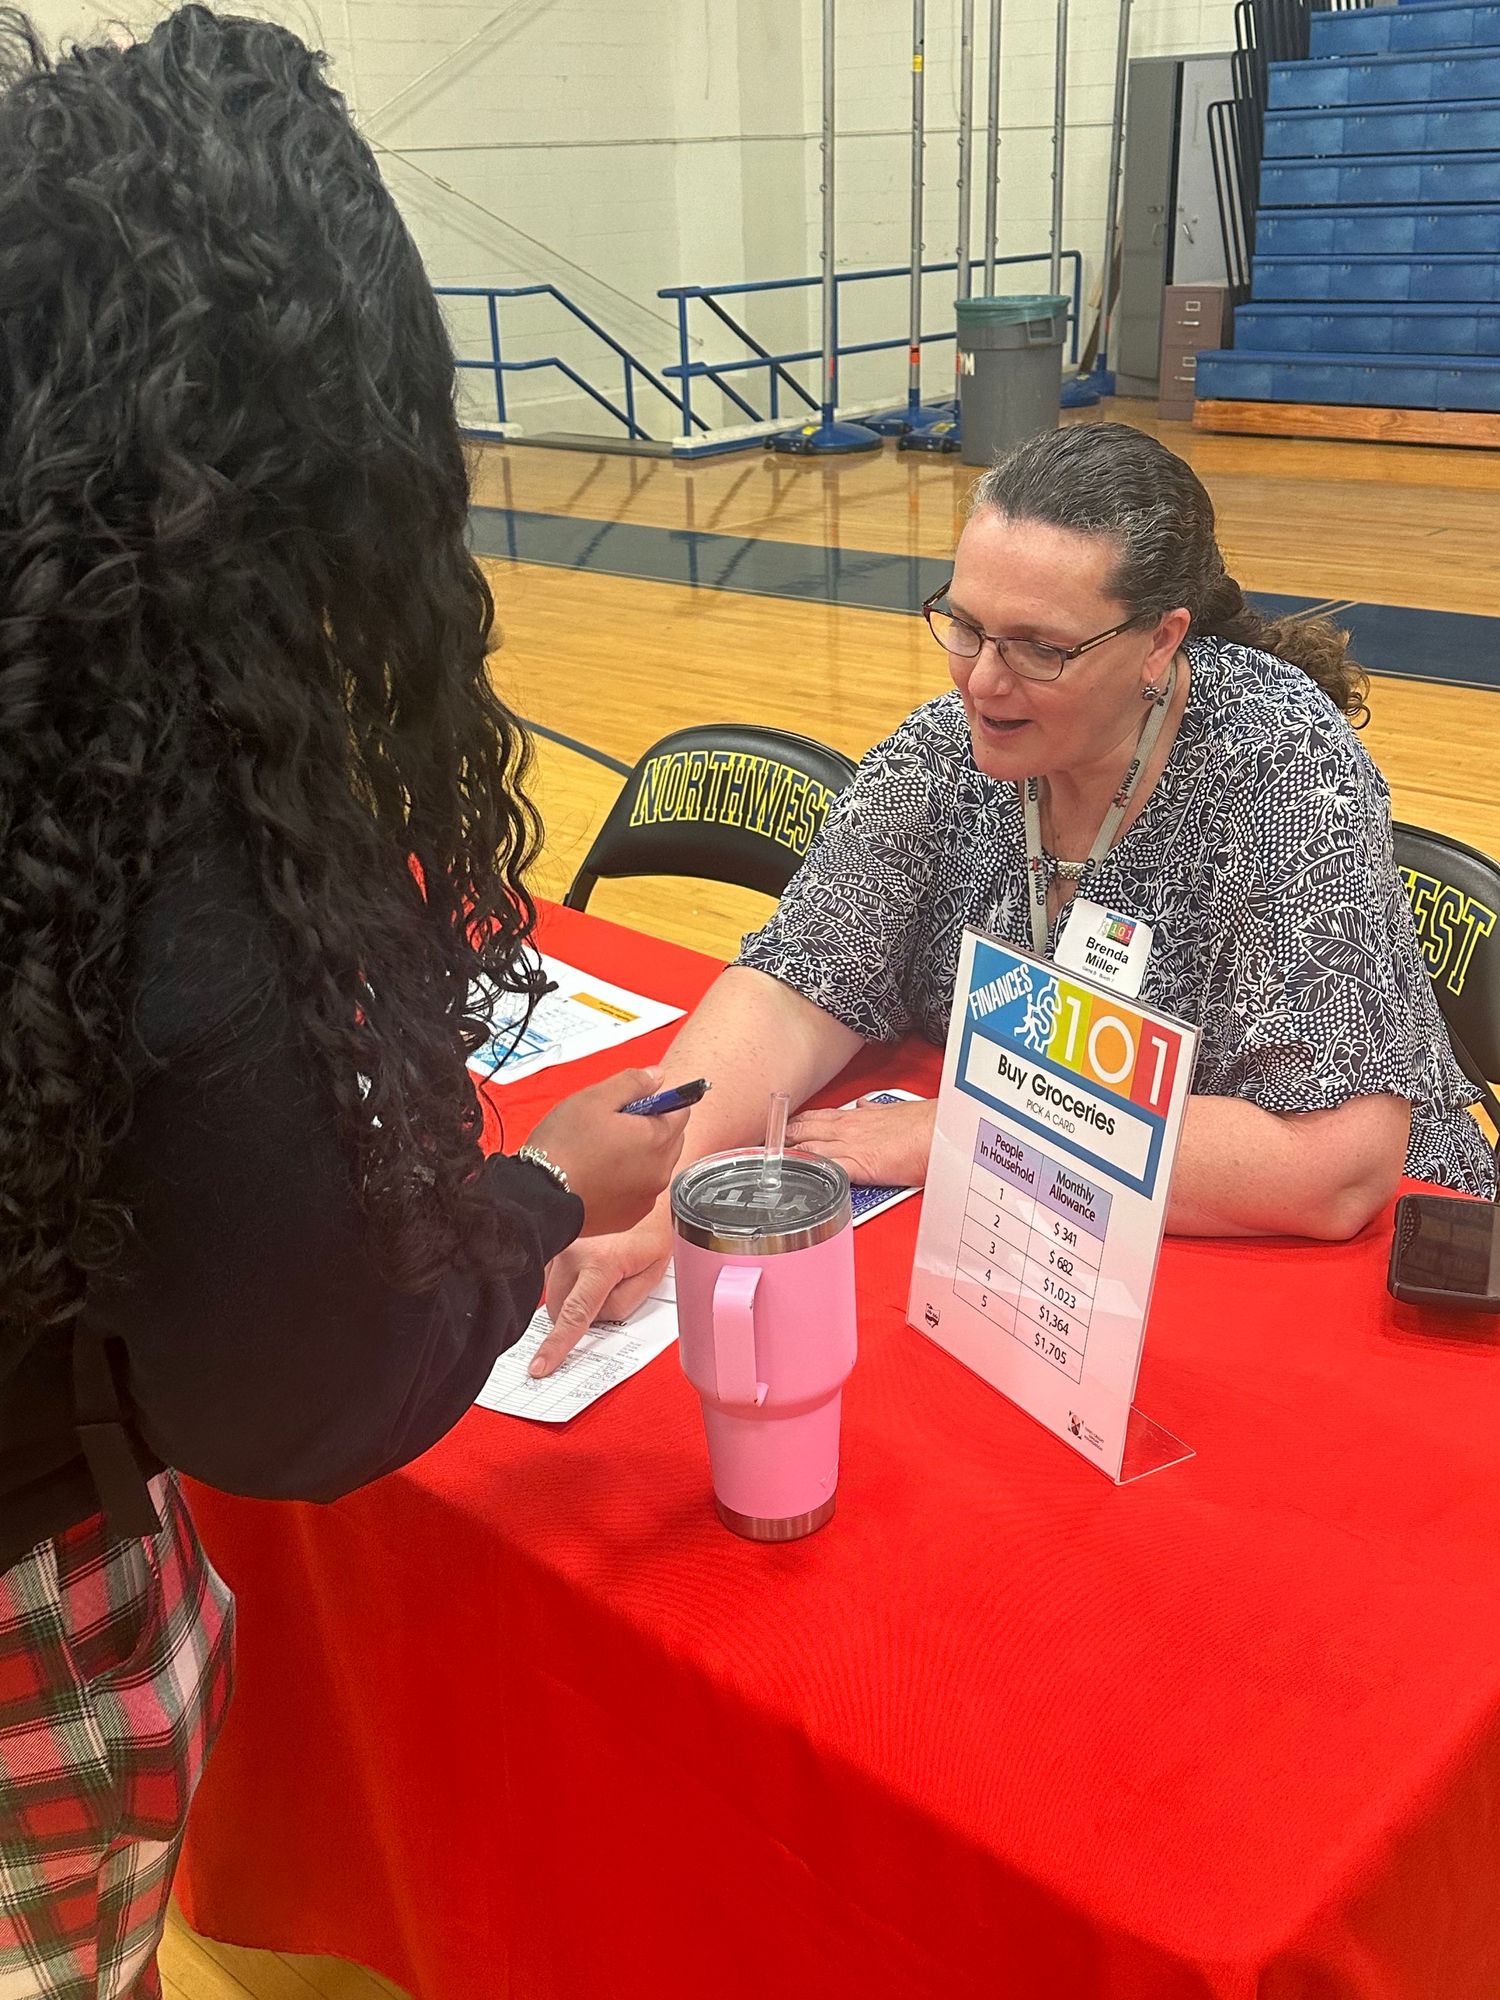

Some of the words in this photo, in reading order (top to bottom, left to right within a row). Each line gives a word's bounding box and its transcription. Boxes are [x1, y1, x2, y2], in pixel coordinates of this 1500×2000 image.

[1121, 758, 1142, 794] NWLSD
[1034, 872, 1045, 907] NWLSD
[1085, 952, 1121, 976] Miller
[1086, 936, 1129, 965] Brenda
[968, 963, 1034, 1021] FINANCES
[997, 1053, 1029, 1090] Buy
[1031, 1073, 1116, 1136] Groceries
[1025, 1099, 1045, 1119] PICK
[1044, 1110, 1051, 1121] A
[1052, 1113, 1076, 1134] CARD
[980, 1141, 989, 1156] In
[989, 1145, 1035, 1184] Household
[995, 1134, 1024, 1162] People
[700, 1186, 812, 1212] YETI
[1000, 1187, 1004, 1200] 1
[1056, 1170, 1095, 1205] Monthly
[1048, 1184, 1096, 1222] Allowance
[993, 1214, 1001, 1228] 2
[988, 1241, 996, 1255] 3
[1061, 1227, 1077, 1247] 341
[985, 1269, 992, 1281] 4
[1057, 1256, 1074, 1277] 682
[981, 1294, 988, 1308] 5
[1043, 1277, 1077, 1309] $1,023
[1039, 1304, 1069, 1336] $1,364
[1034, 1332, 1067, 1365] $1,705
